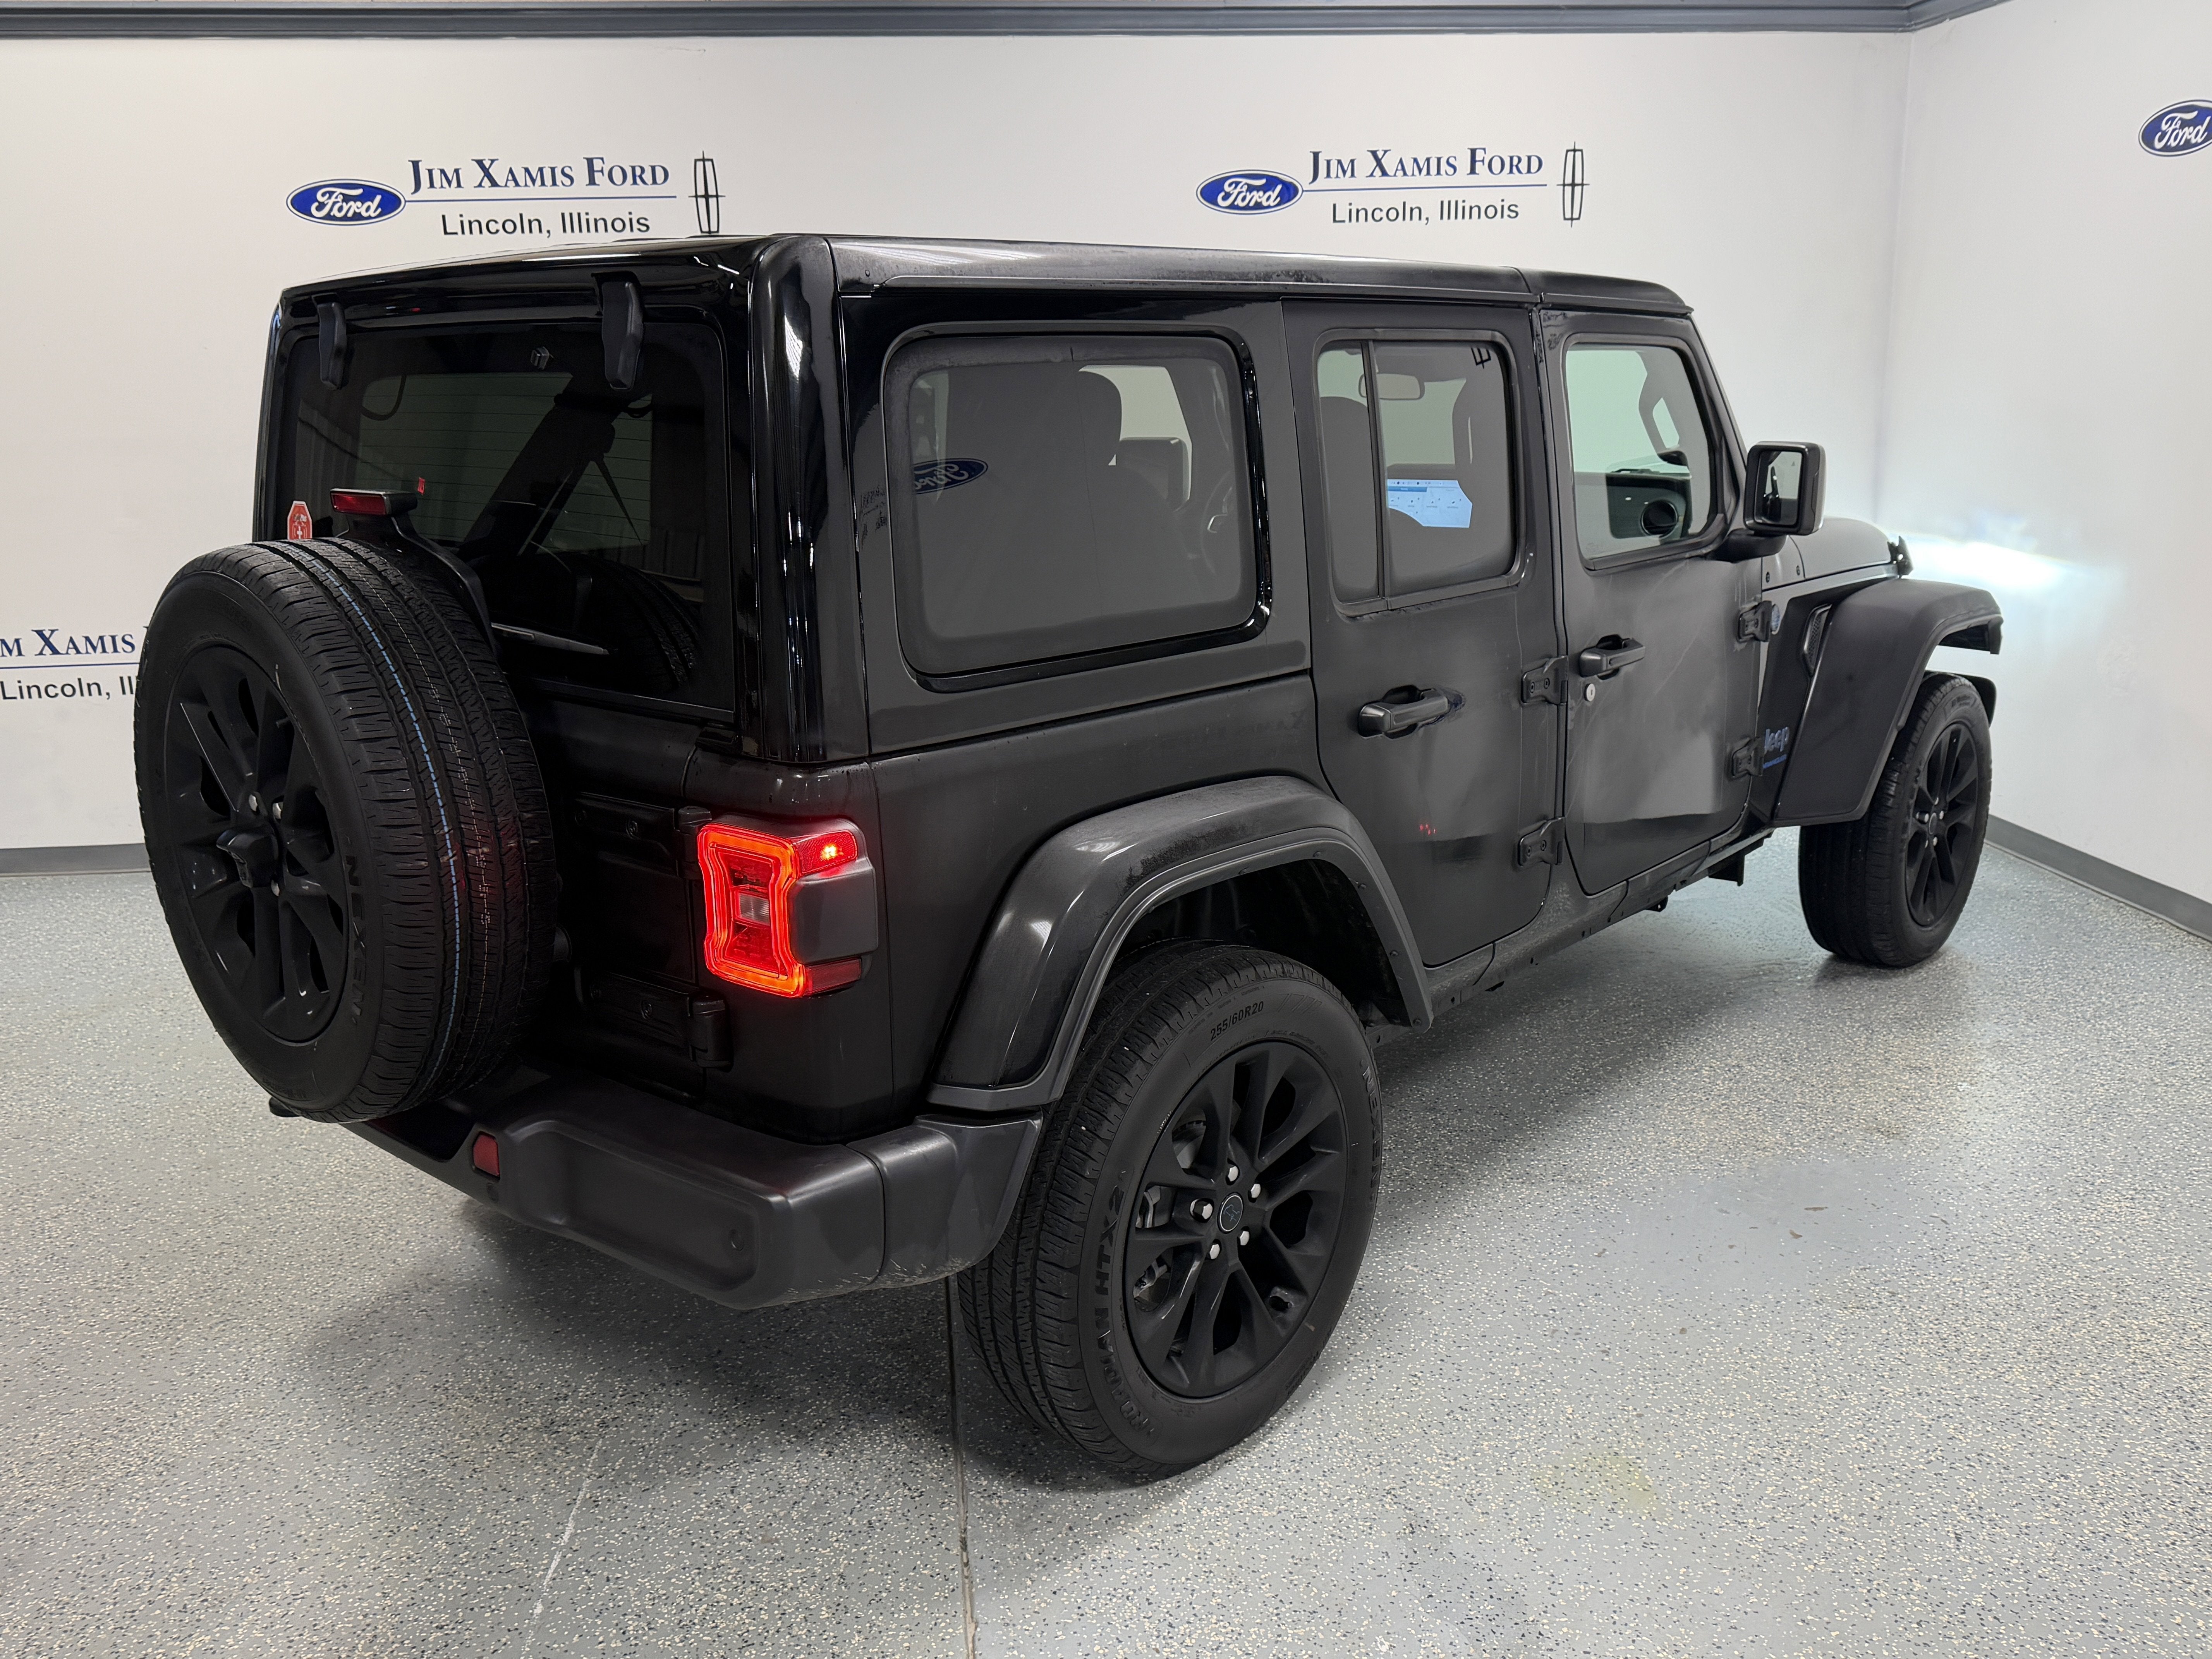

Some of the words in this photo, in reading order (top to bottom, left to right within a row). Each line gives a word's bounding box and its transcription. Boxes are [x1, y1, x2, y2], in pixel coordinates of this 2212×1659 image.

[2154, 110, 2211, 149] Ford
[408, 160, 464, 195] JIM
[471, 158, 574, 188] XAMIS
[583, 157, 669, 186] FORD
[1309, 151, 1356, 185] JIM
[1366, 149, 1457, 178] XAMIS
[1467, 148, 1543, 175] FORD
[311, 187, 382, 218] Ford
[1217, 178, 1283, 207] Ford
[441, 213, 551, 239] Lincoln,
[561, 211, 651, 234] Illinois
[1333, 201, 1430, 225] Lincoln,
[1440, 199, 1520, 220] Illinois
[31, 629, 136, 656] XAMIS
[0, 678, 111, 700] Lincoln,
[1764, 726, 1790, 752] Jeep
[345, 855, 366, 1017] NEXEN
[1210, 1001, 1264, 1041] 255/60R20
[1362, 1066, 1381, 1188] NEXEN
